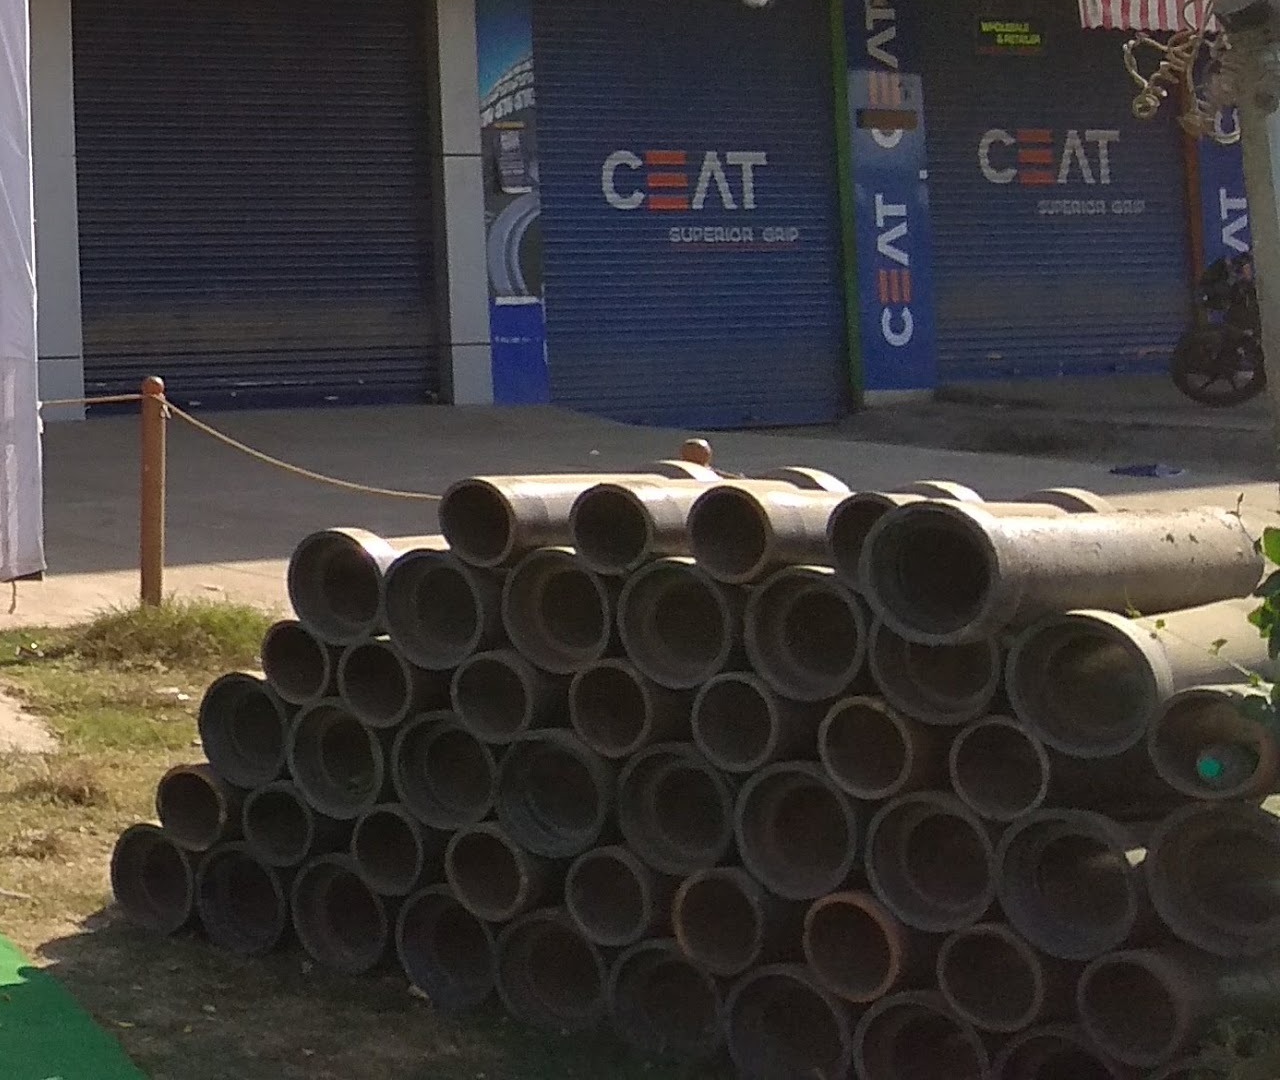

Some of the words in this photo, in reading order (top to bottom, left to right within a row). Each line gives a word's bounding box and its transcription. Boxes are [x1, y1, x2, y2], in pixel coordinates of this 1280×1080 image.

[601, 150, 767, 211] CEAT
[977, 128, 1121, 187] CEAT
[669, 226, 754, 242] SUPERIOR
[875, 193, 913, 347] CEAT
